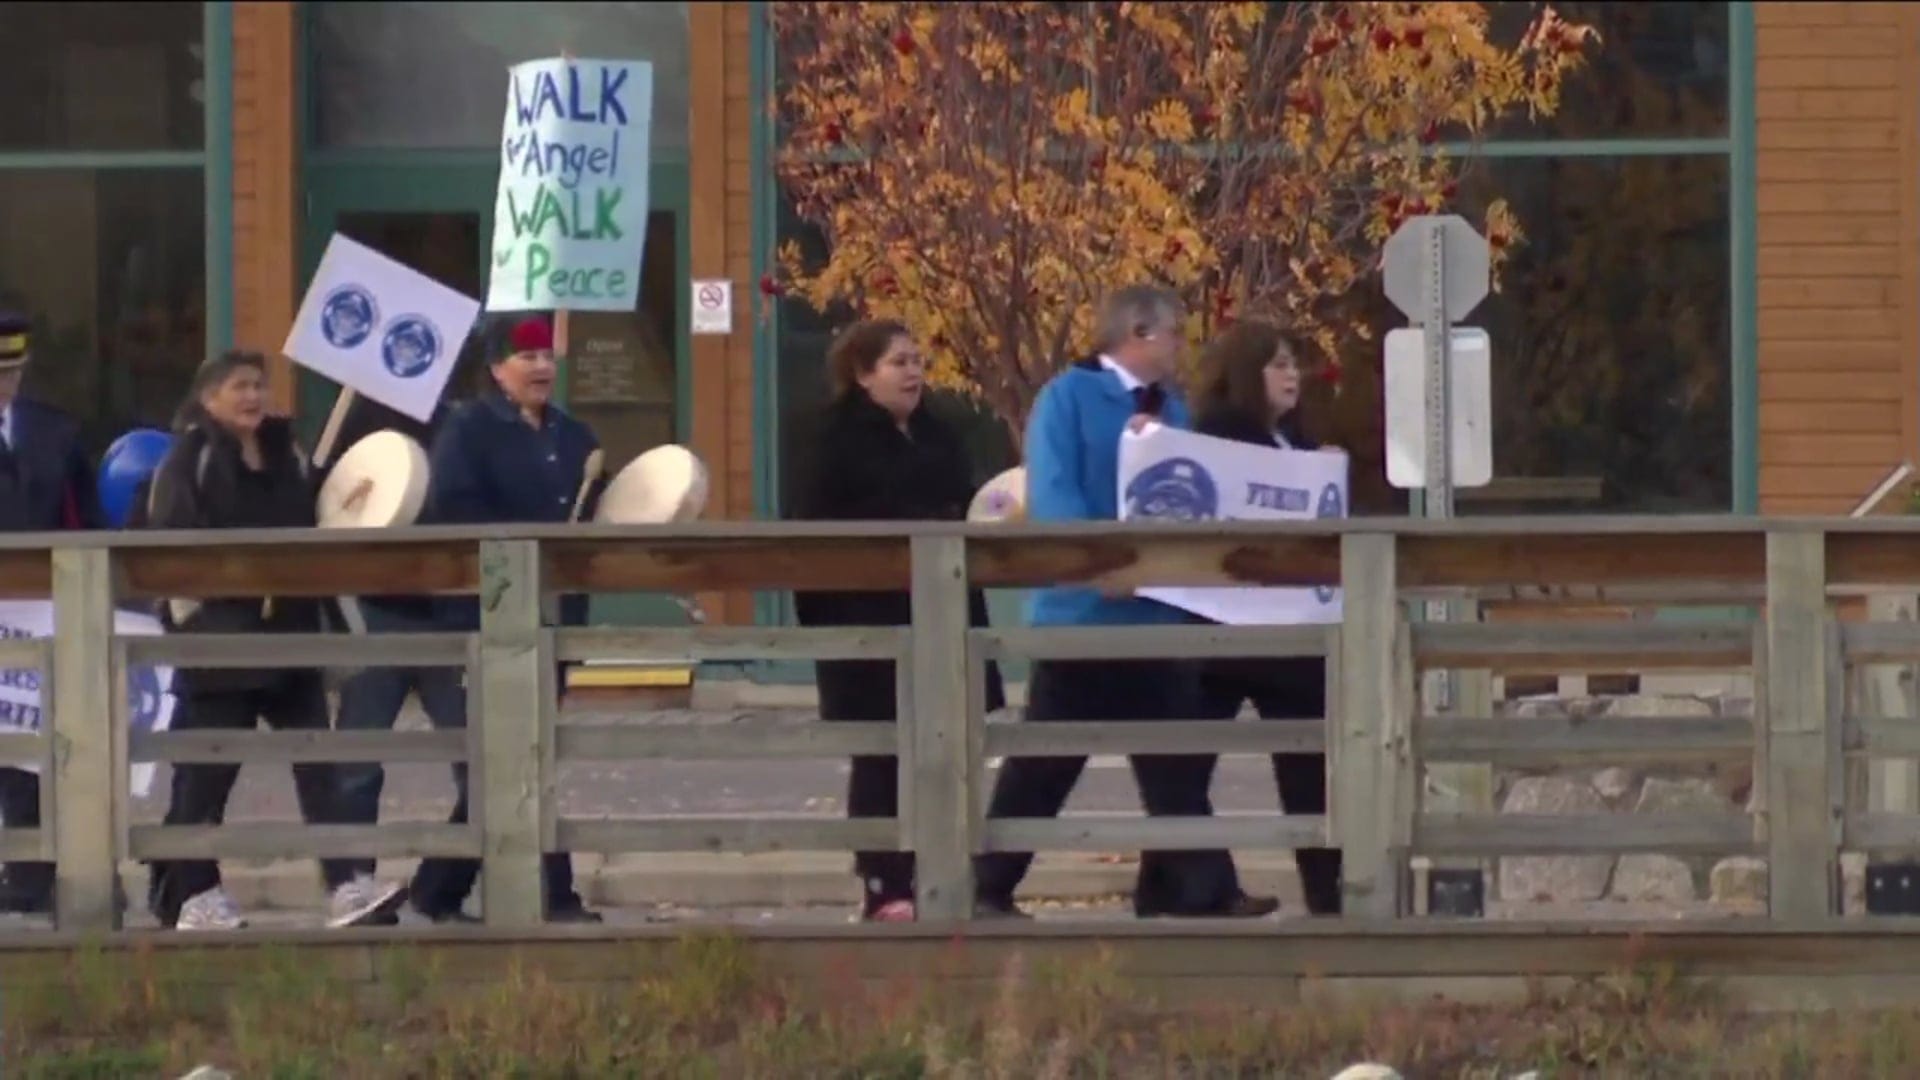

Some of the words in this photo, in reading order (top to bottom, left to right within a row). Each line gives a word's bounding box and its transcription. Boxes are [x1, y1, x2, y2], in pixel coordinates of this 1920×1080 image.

[514, 66, 628, 127] WALK
[521, 129, 619, 189] Angel
[507, 183, 623, 240] WALK
[526, 243, 627, 301] Peace
